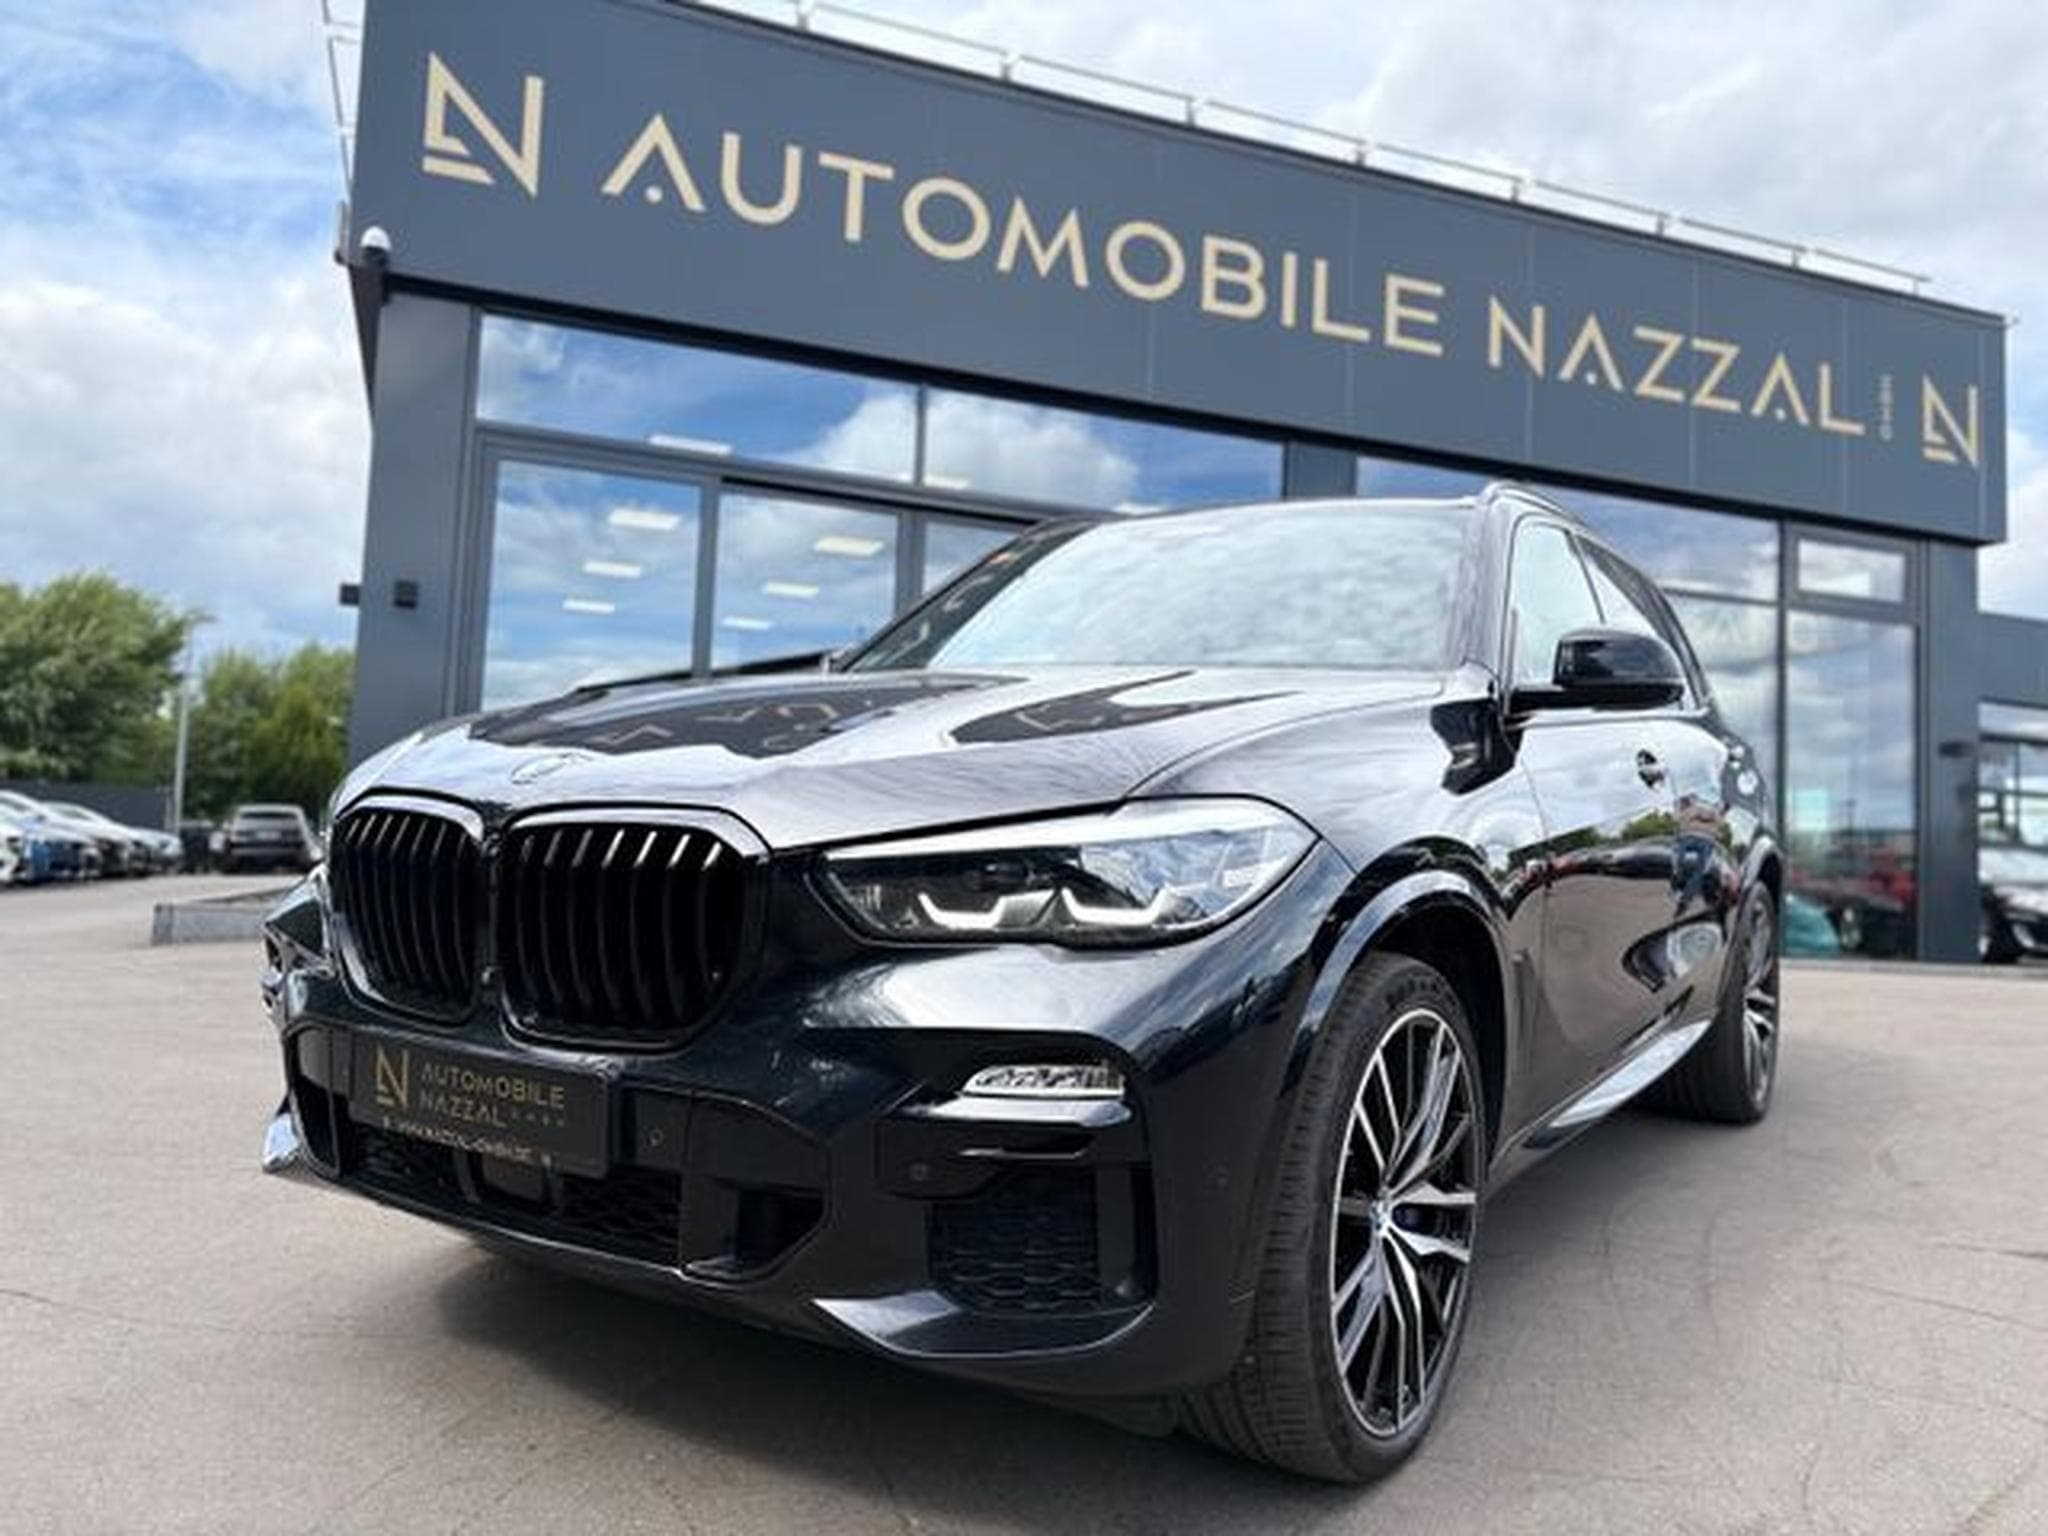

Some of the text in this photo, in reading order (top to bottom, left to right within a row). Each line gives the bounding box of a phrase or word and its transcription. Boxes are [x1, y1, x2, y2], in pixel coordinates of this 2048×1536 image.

[601, 112, 1444, 357] AUTOMOBILE
[1487, 295, 1866, 436] NAZZAL
[419, 1090, 507, 1128] NAZZAL
[420, 1061, 565, 1110] AUTOMOBILE
